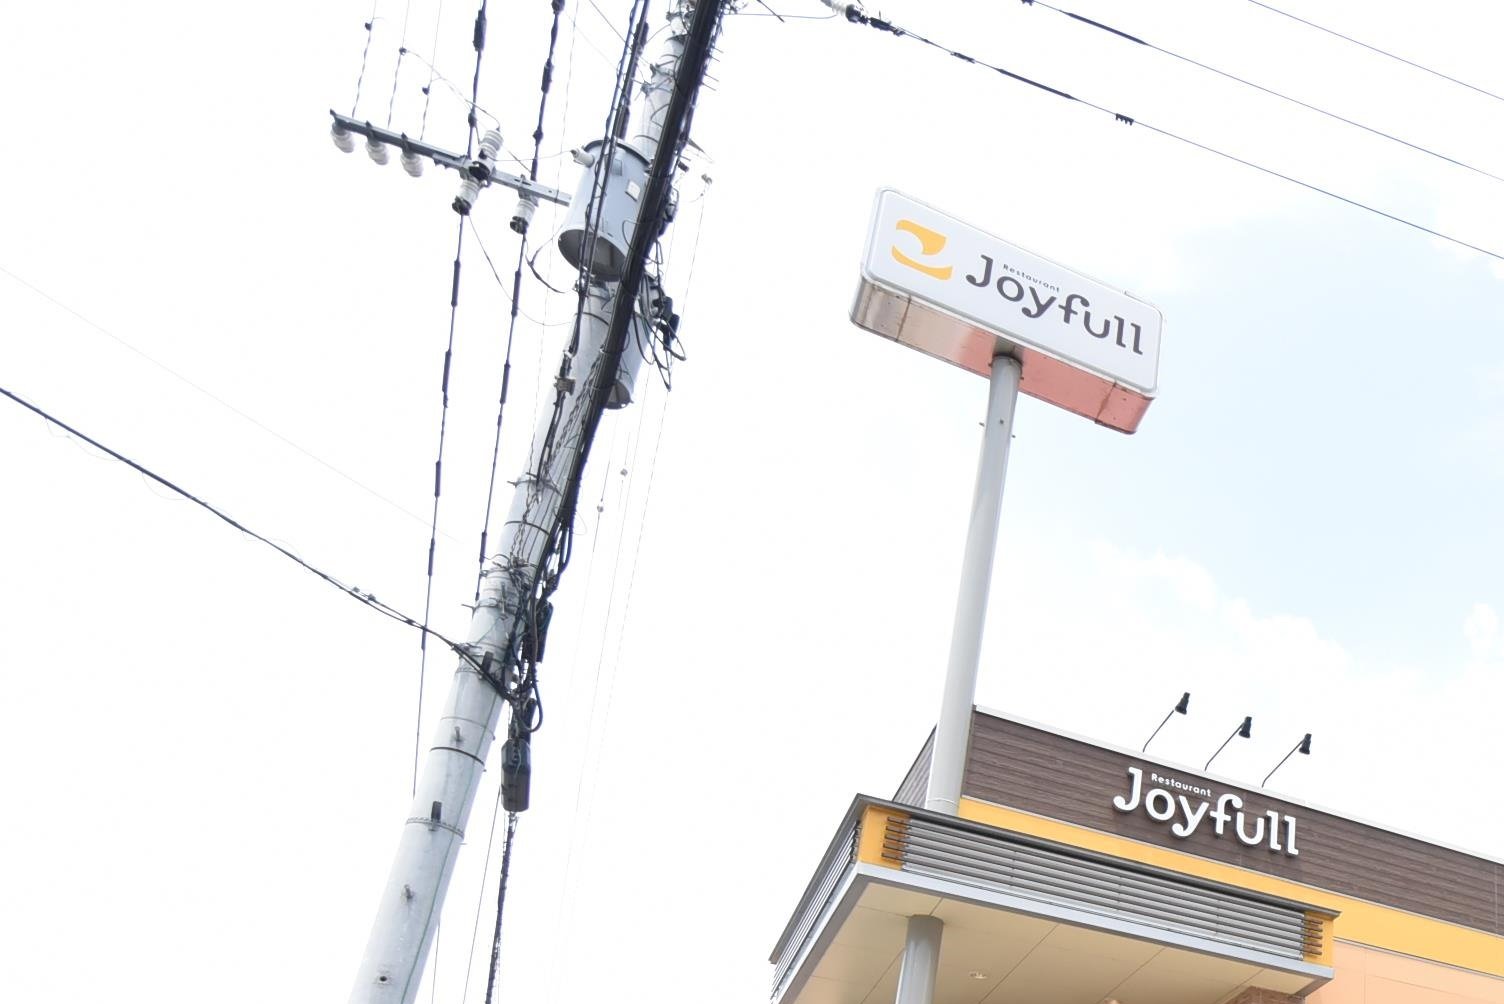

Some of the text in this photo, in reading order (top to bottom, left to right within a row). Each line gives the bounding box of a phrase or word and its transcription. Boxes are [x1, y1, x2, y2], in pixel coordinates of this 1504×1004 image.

[965, 254, 1144, 355] Joyfull
[1003, 264, 1060, 293] Restaurant
[1113, 766, 1299, 856] Joyfull
[1151, 773, 1212, 797] Restaurant
